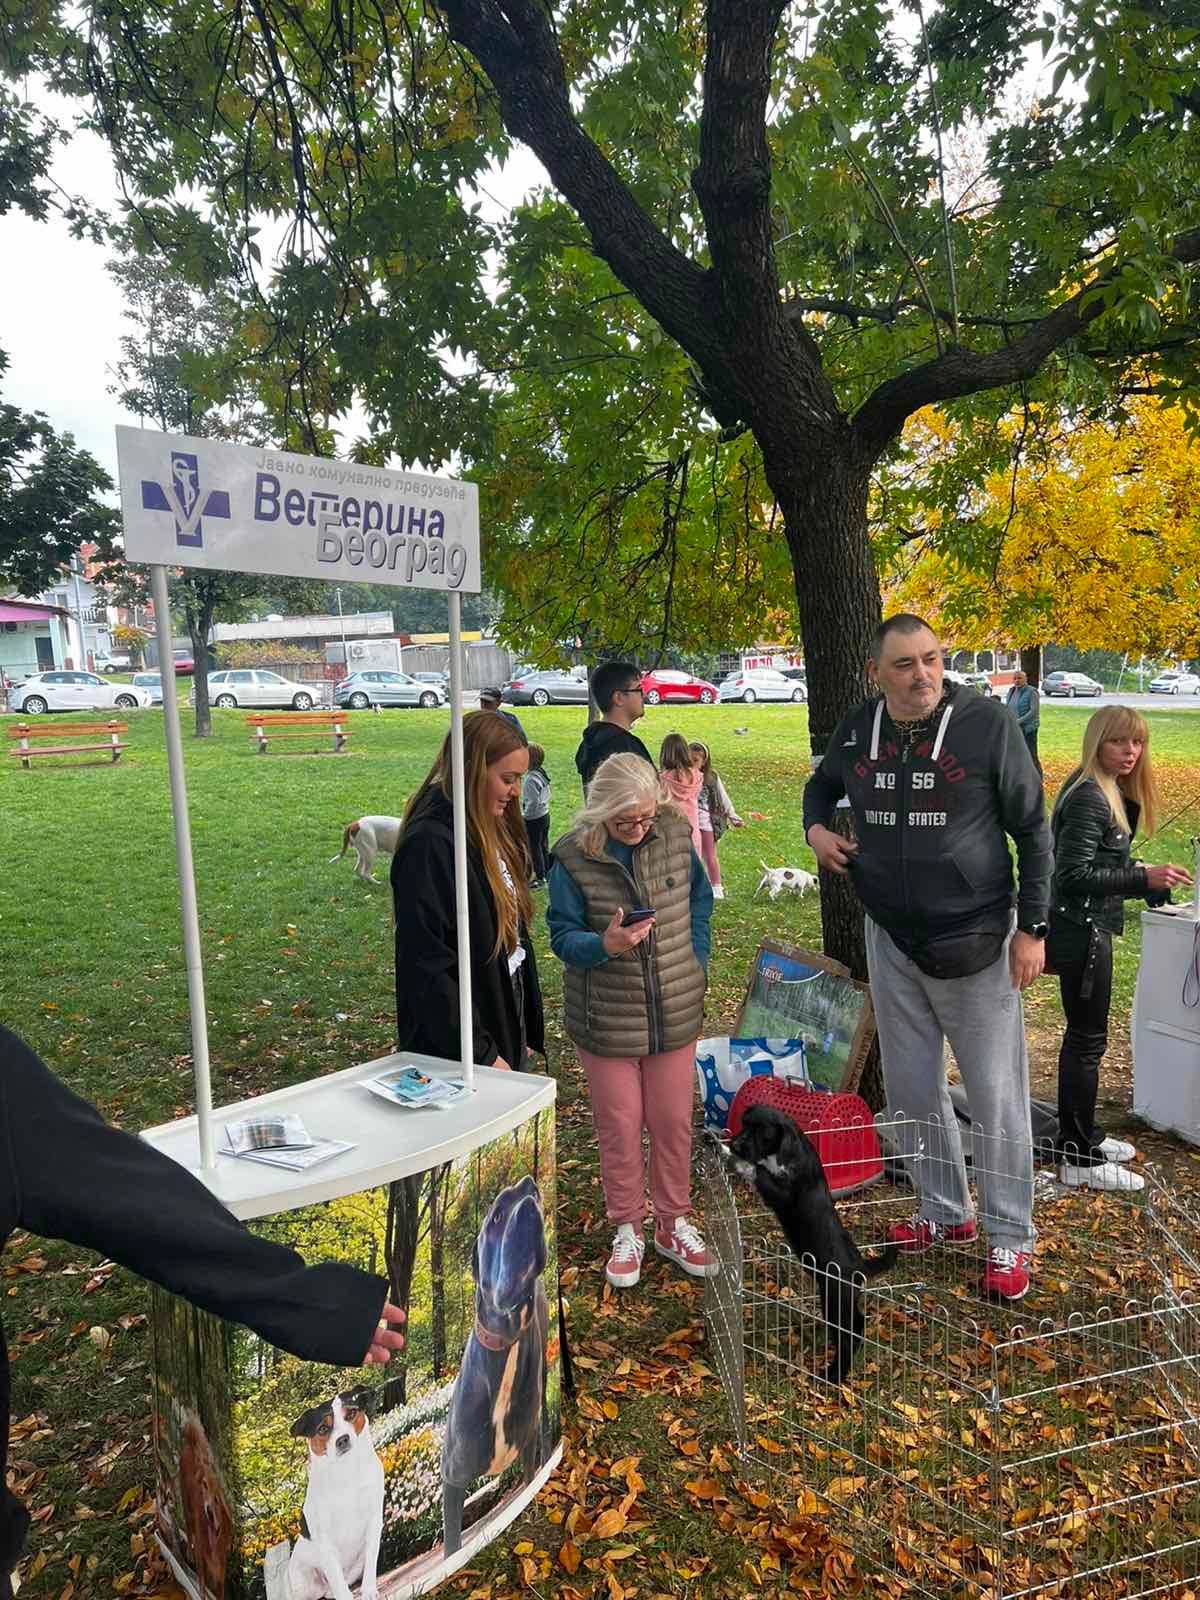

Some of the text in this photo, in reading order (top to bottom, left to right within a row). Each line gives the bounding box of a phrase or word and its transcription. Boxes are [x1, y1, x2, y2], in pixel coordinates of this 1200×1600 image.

[317, 512, 467, 588] Београд
[912, 772, 936, 790] 56
[865, 810, 948, 826] UNITED STATES
